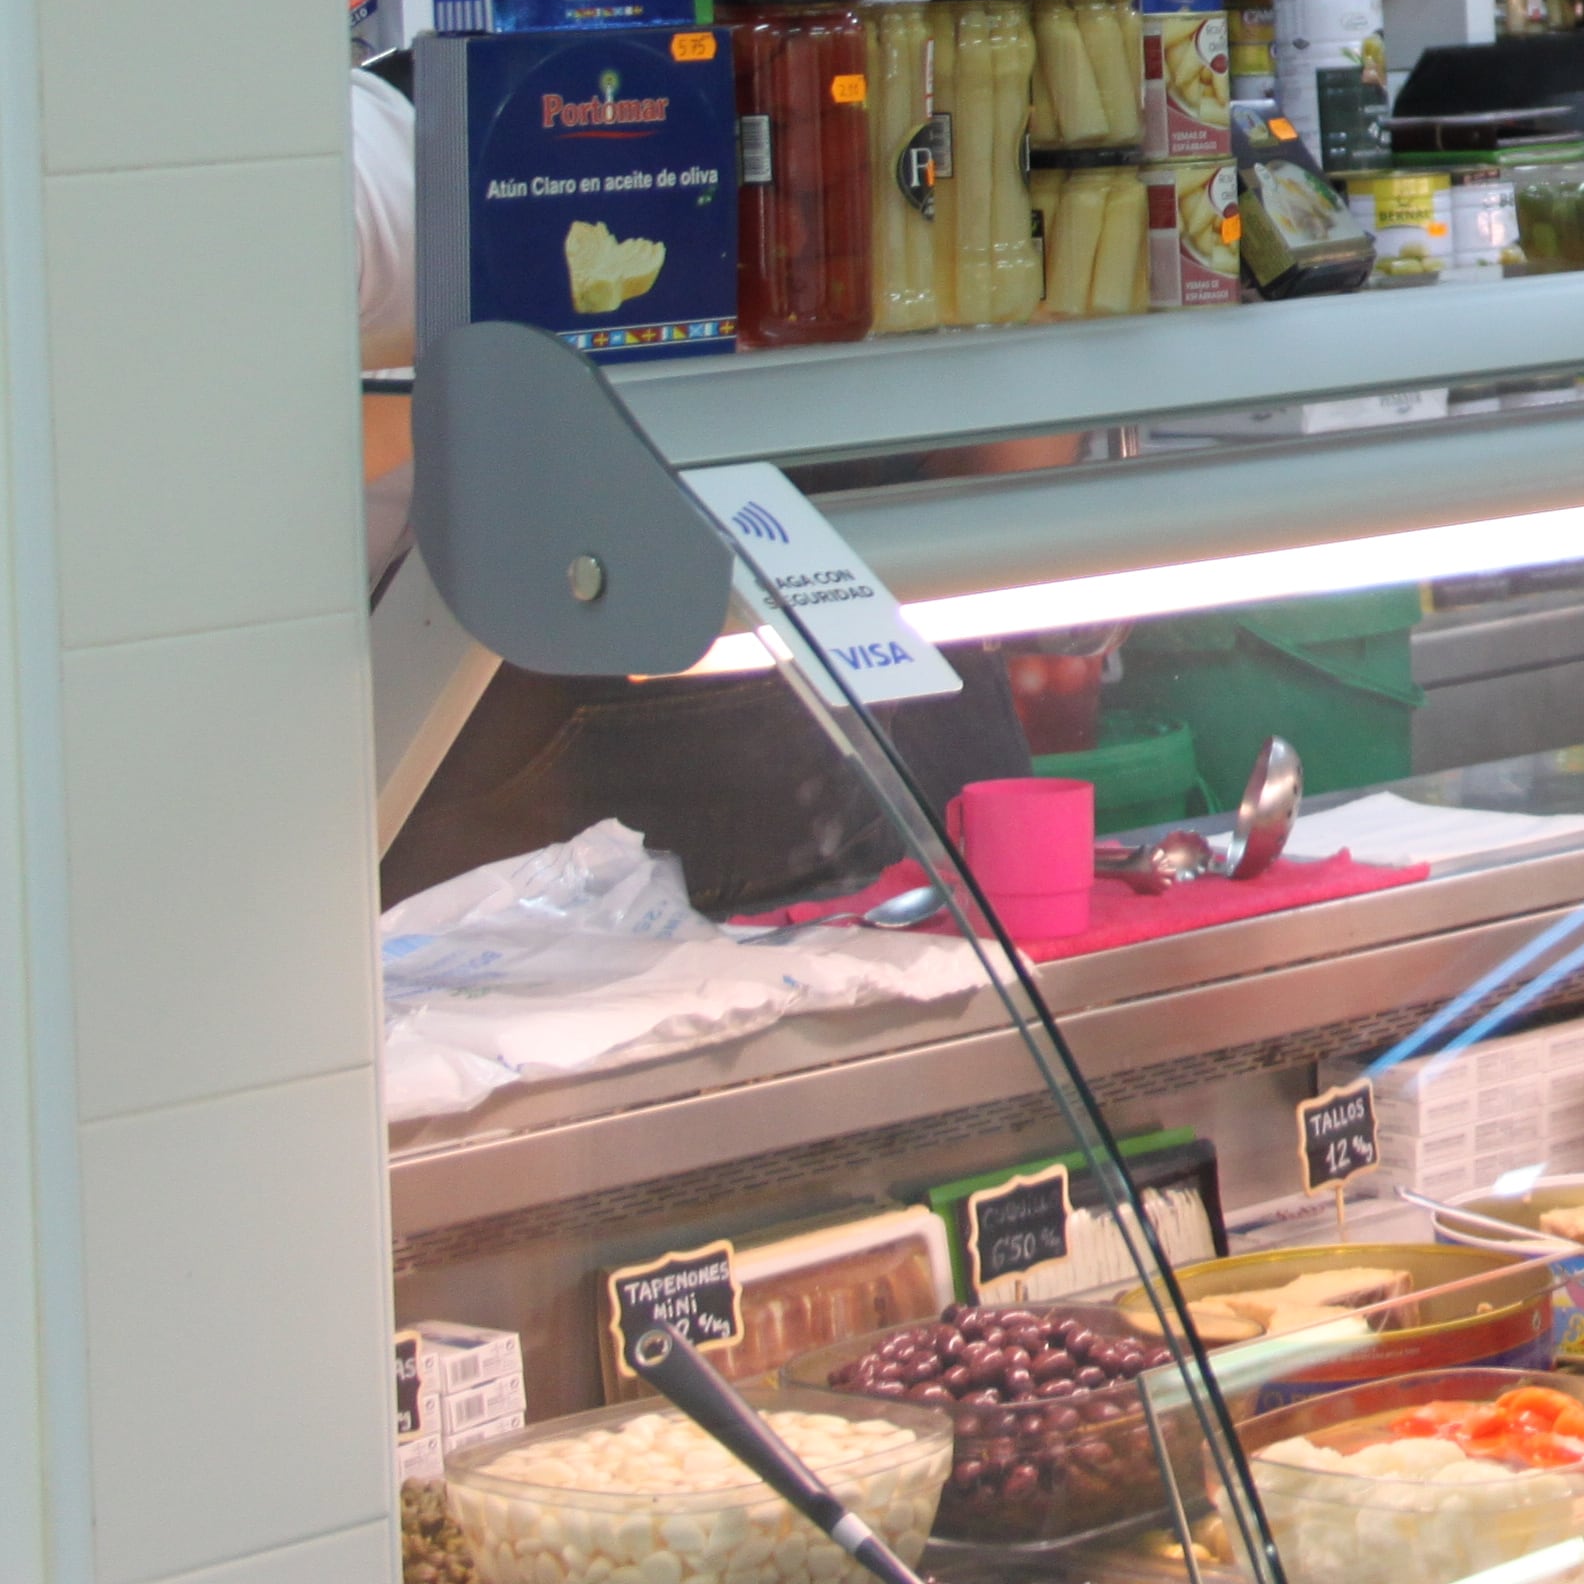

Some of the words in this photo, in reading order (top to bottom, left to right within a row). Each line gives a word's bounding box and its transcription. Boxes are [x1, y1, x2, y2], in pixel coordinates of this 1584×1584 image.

[541, 93, 669, 129] Portomar
[486, 175, 528, 199] Atún
[531, 176, 577, 197] Claro
[580, 178, 601, 193] en
[604, 170, 653, 192] aceite
[656, 169, 677, 187] de
[680, 166, 719, 186] oliva
[813, 569, 856, 586] CON
[829, 641, 915, 670] VISA
[1309, 1096, 1366, 1136] TALLOS
[1325, 1137, 1352, 1174] 12
